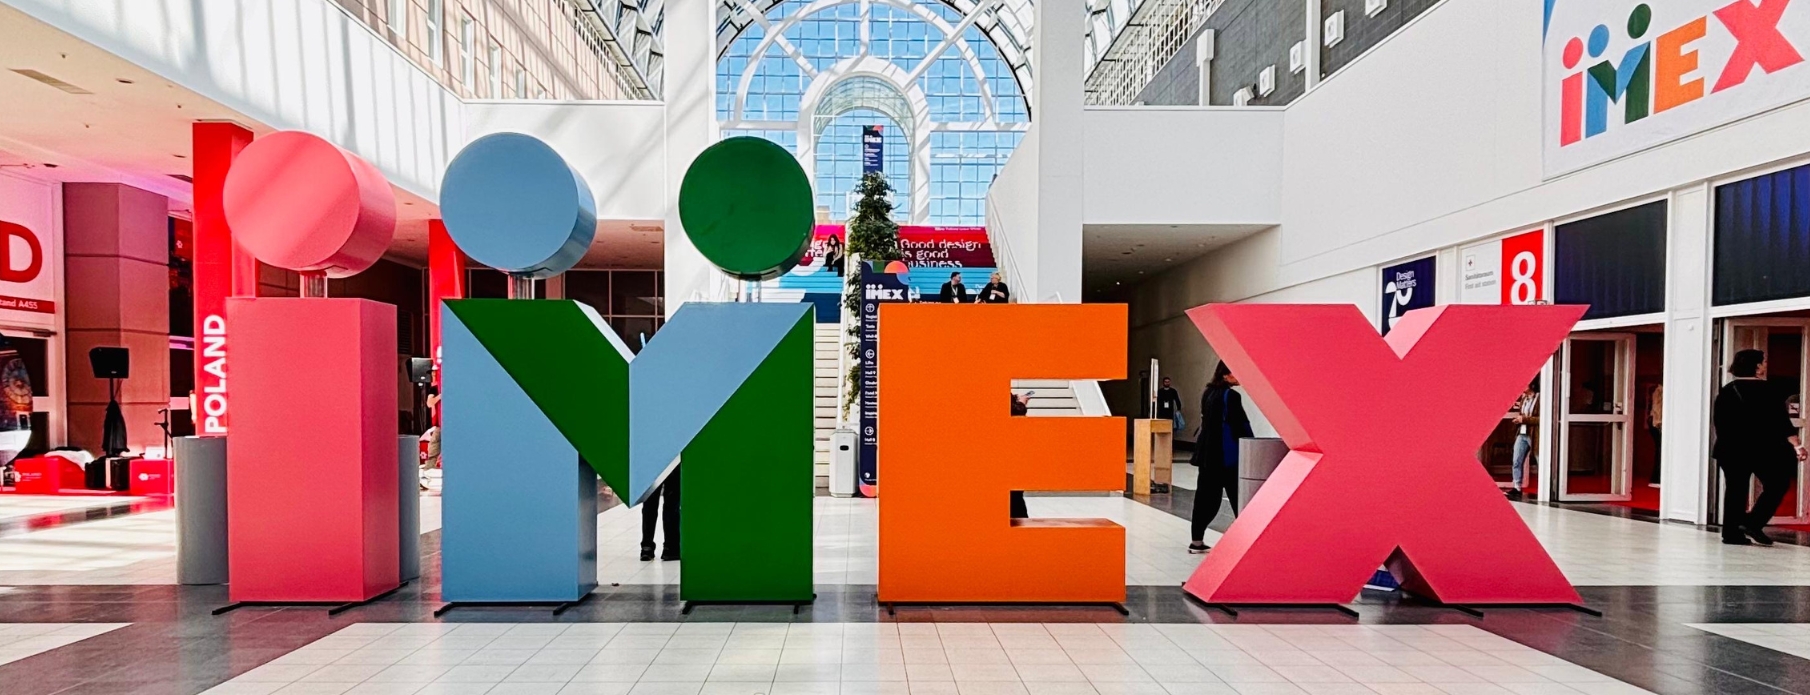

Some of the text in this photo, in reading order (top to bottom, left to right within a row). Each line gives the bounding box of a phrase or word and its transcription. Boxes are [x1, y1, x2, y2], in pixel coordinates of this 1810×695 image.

[900, 239, 981, 251] Good design
[916, 249, 949, 260] good
[1396, 270, 1415, 280] Design
[1510, 251, 1536, 305] 8
[203, 314, 227, 433] POLAND
